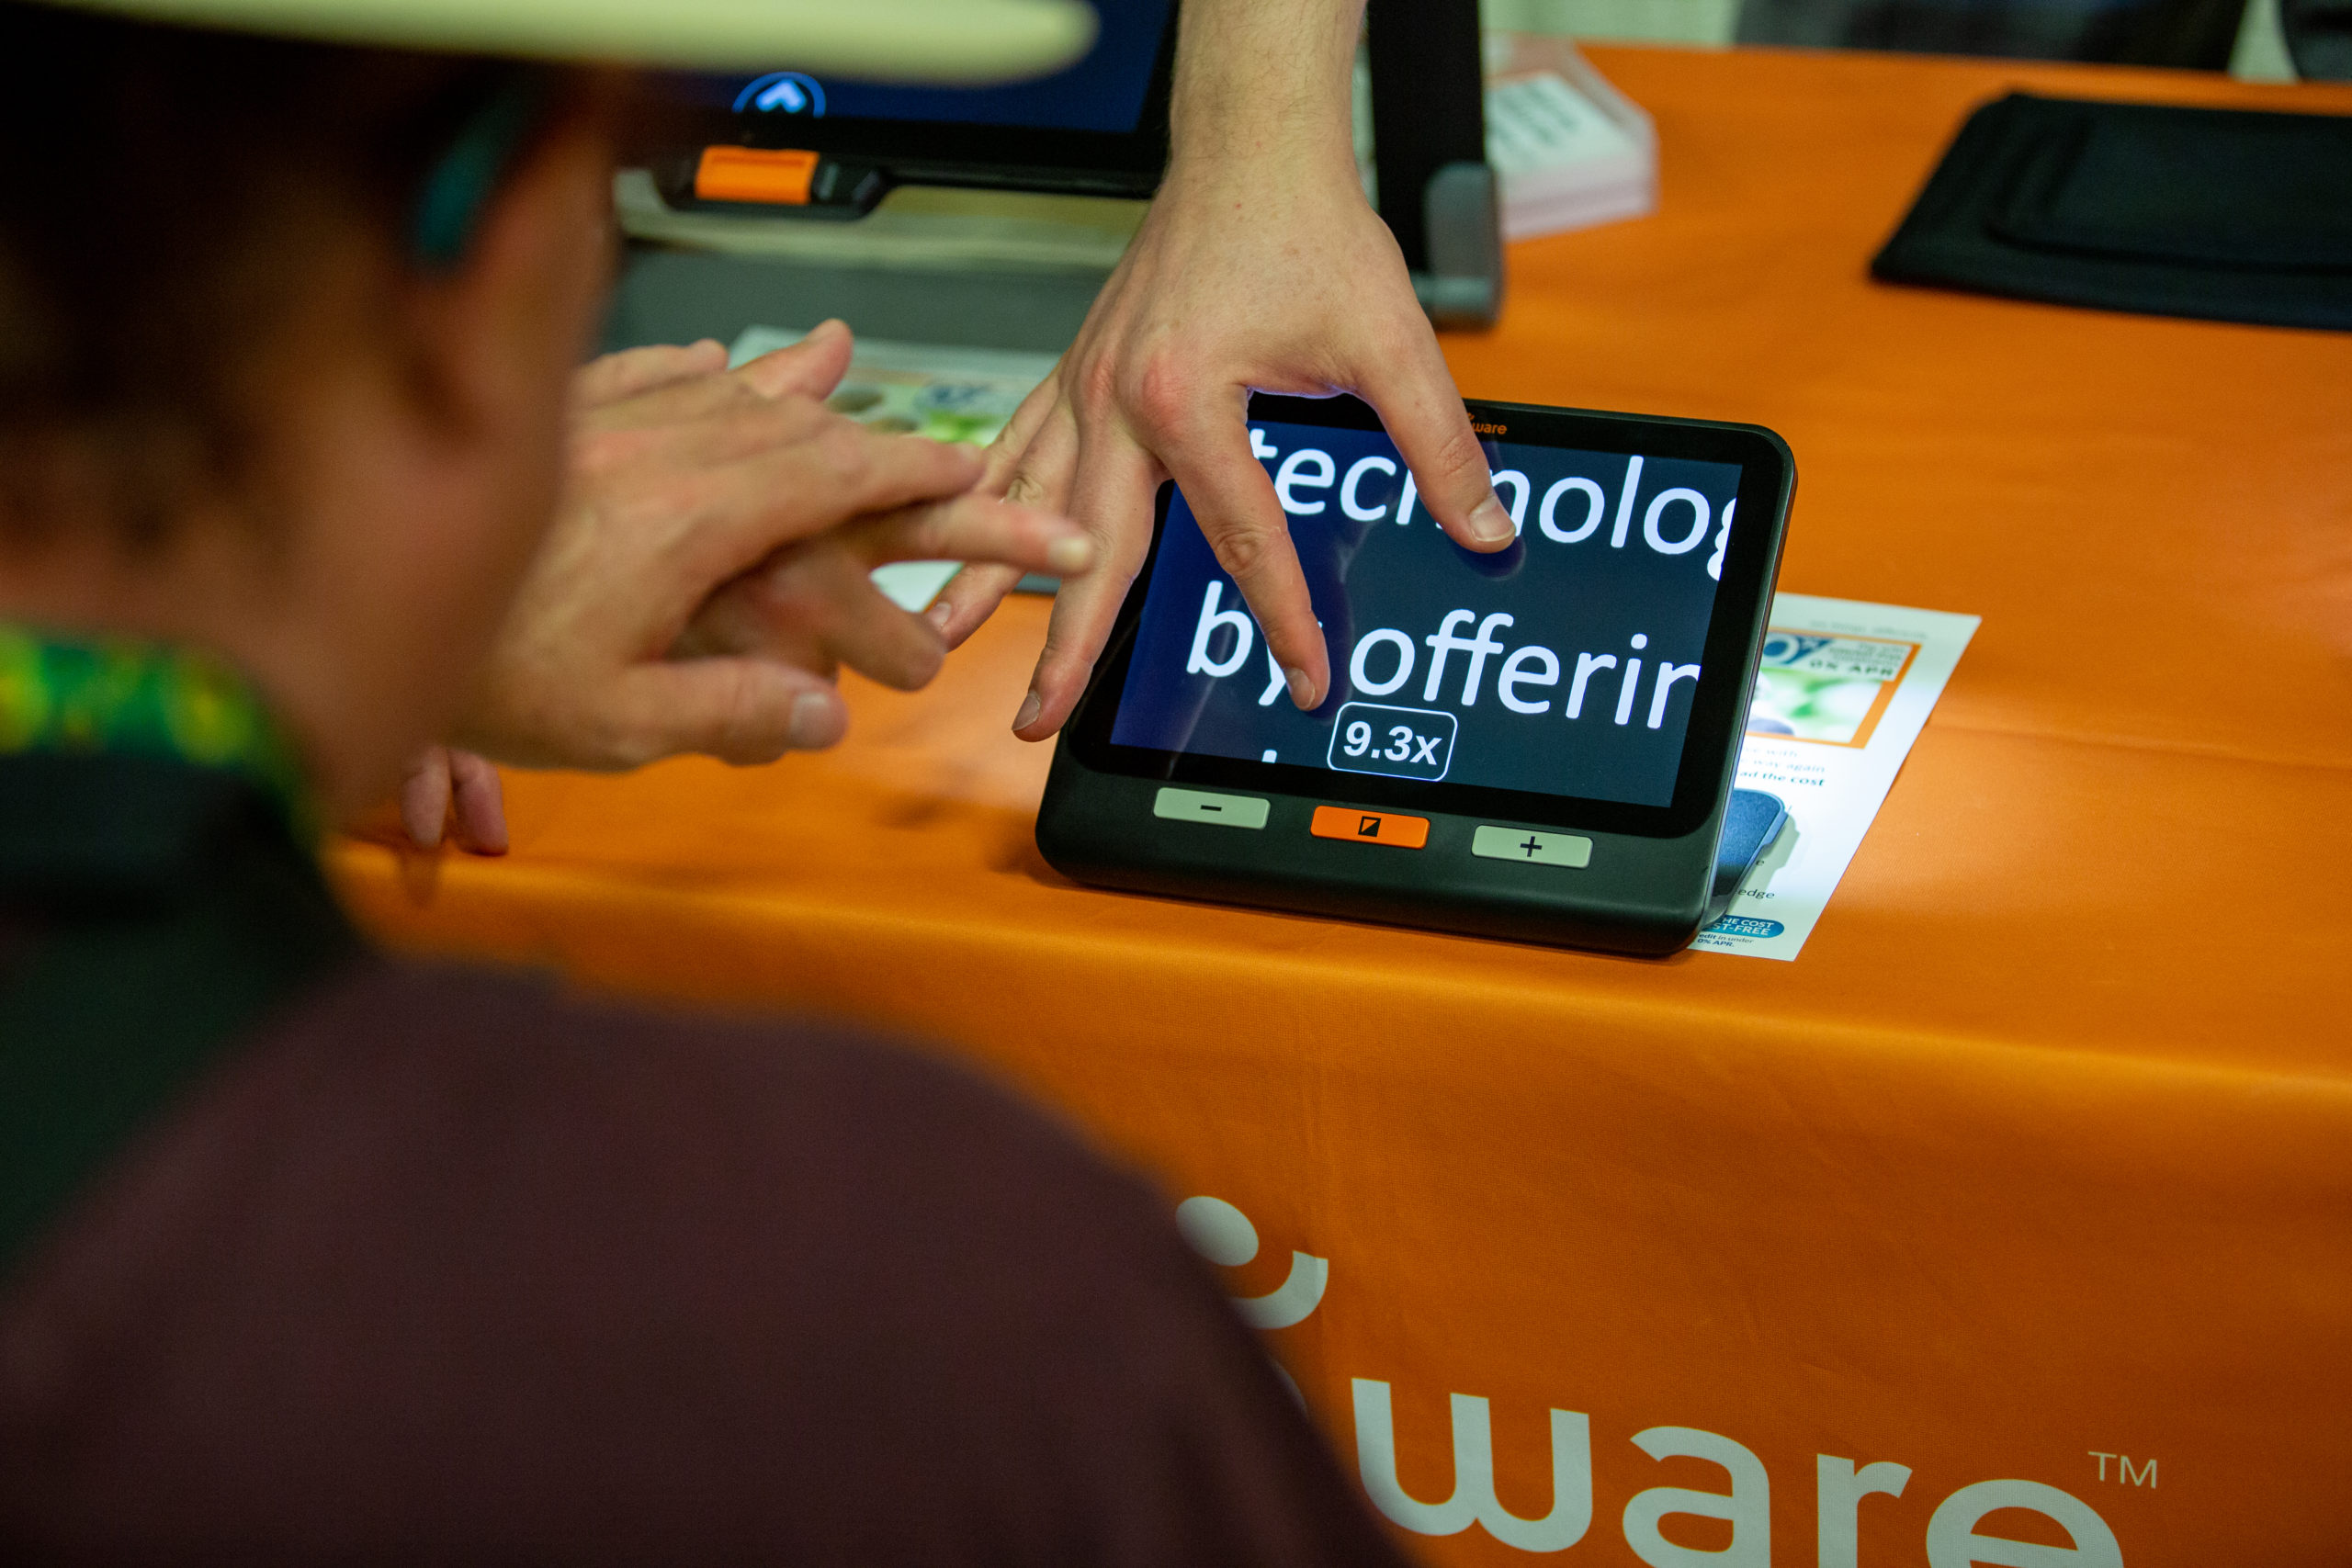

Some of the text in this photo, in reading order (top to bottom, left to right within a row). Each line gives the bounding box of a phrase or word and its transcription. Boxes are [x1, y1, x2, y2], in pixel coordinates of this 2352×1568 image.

[1250, 428, 1736, 581] tecnolo
[1344, 721, 1442, 766] 9.3x
[1762, 773, 1786, 782] the
[1791, 777, 1826, 786] cost
[1741, 919, 1775, 929] COST
[2086, 1450, 2160, 1490] TM
